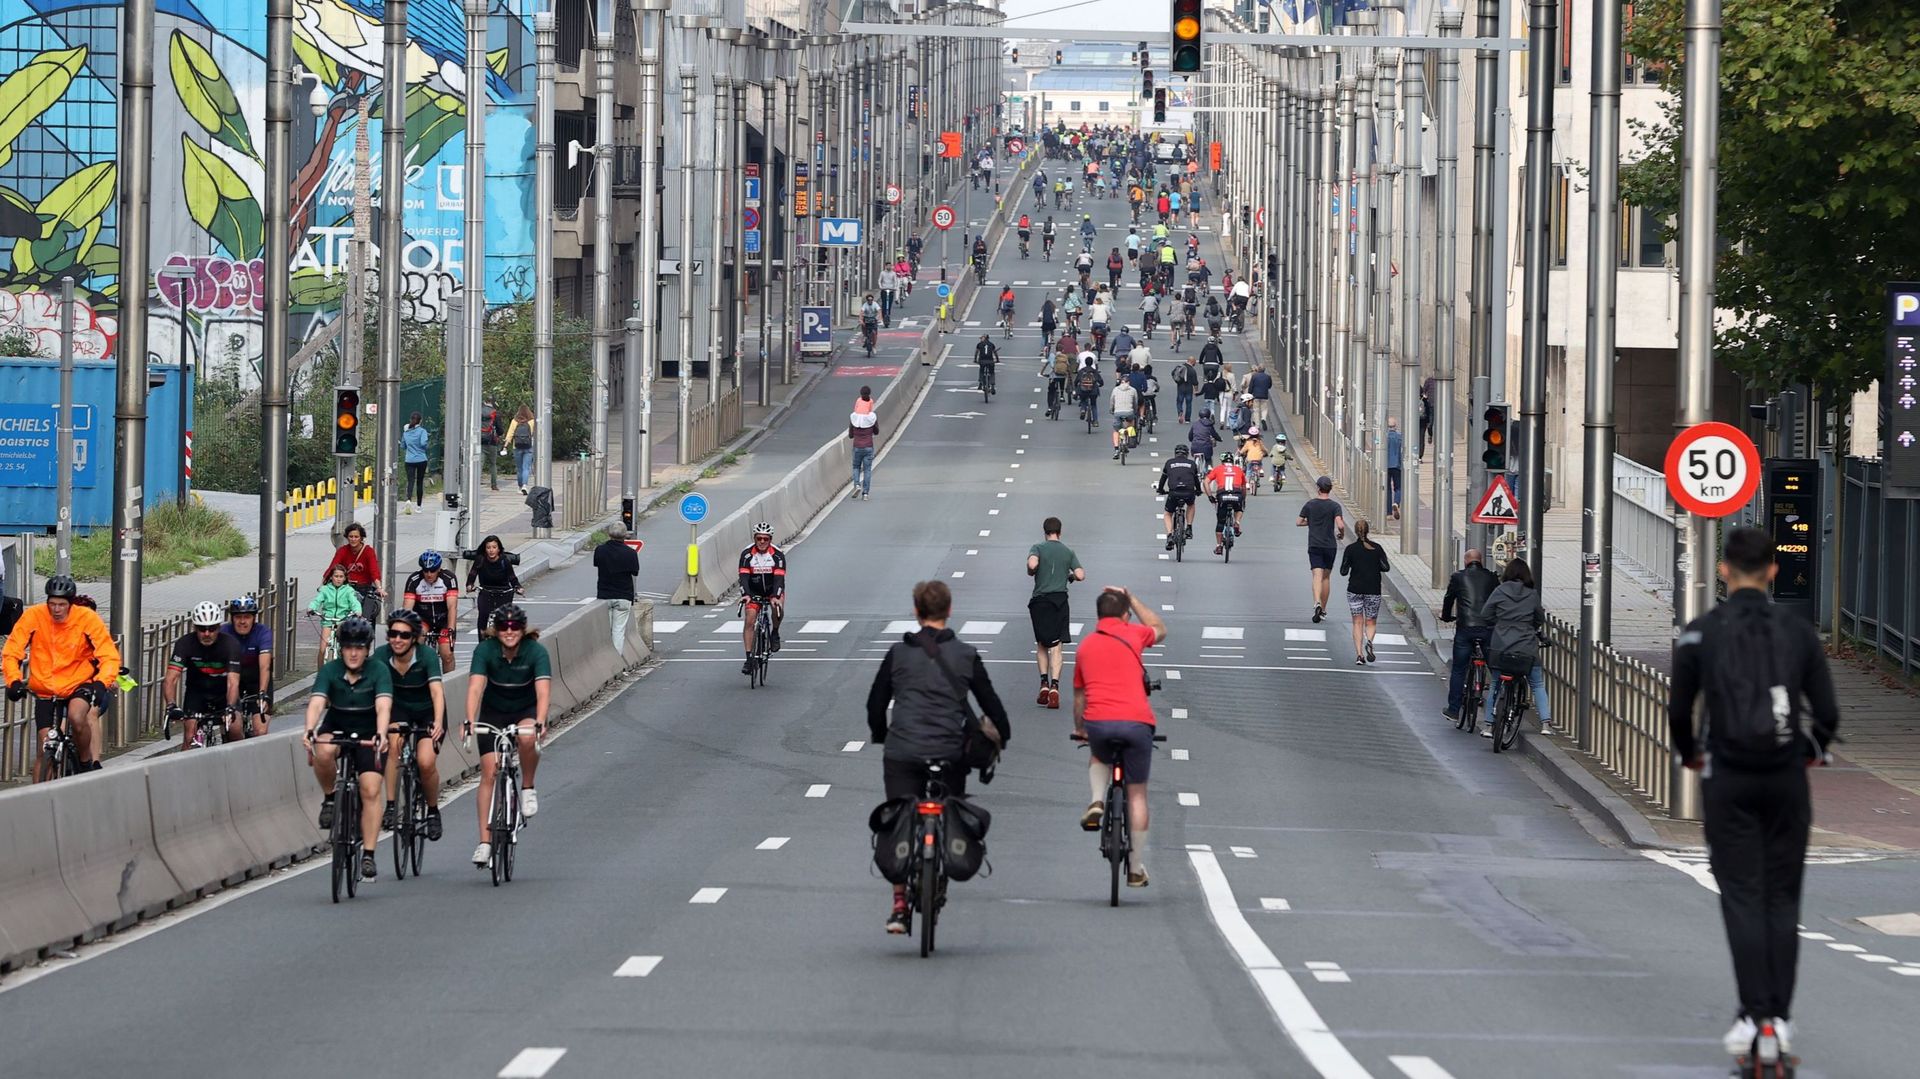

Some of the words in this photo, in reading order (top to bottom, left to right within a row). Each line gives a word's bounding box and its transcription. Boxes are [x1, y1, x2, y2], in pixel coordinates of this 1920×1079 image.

[938, 212, 950, 221] 50
[822, 221, 858, 242] M
[1896, 295, 1919, 321] P
[803, 312, 819, 335] P
[0, 438, 50, 447] OGISTICS
[1689, 449, 1736, 480] 50
[1700, 483, 1725, 496] km
[1792, 523, 1809, 532] 418
[1776, 544, 1808, 552] 442290
